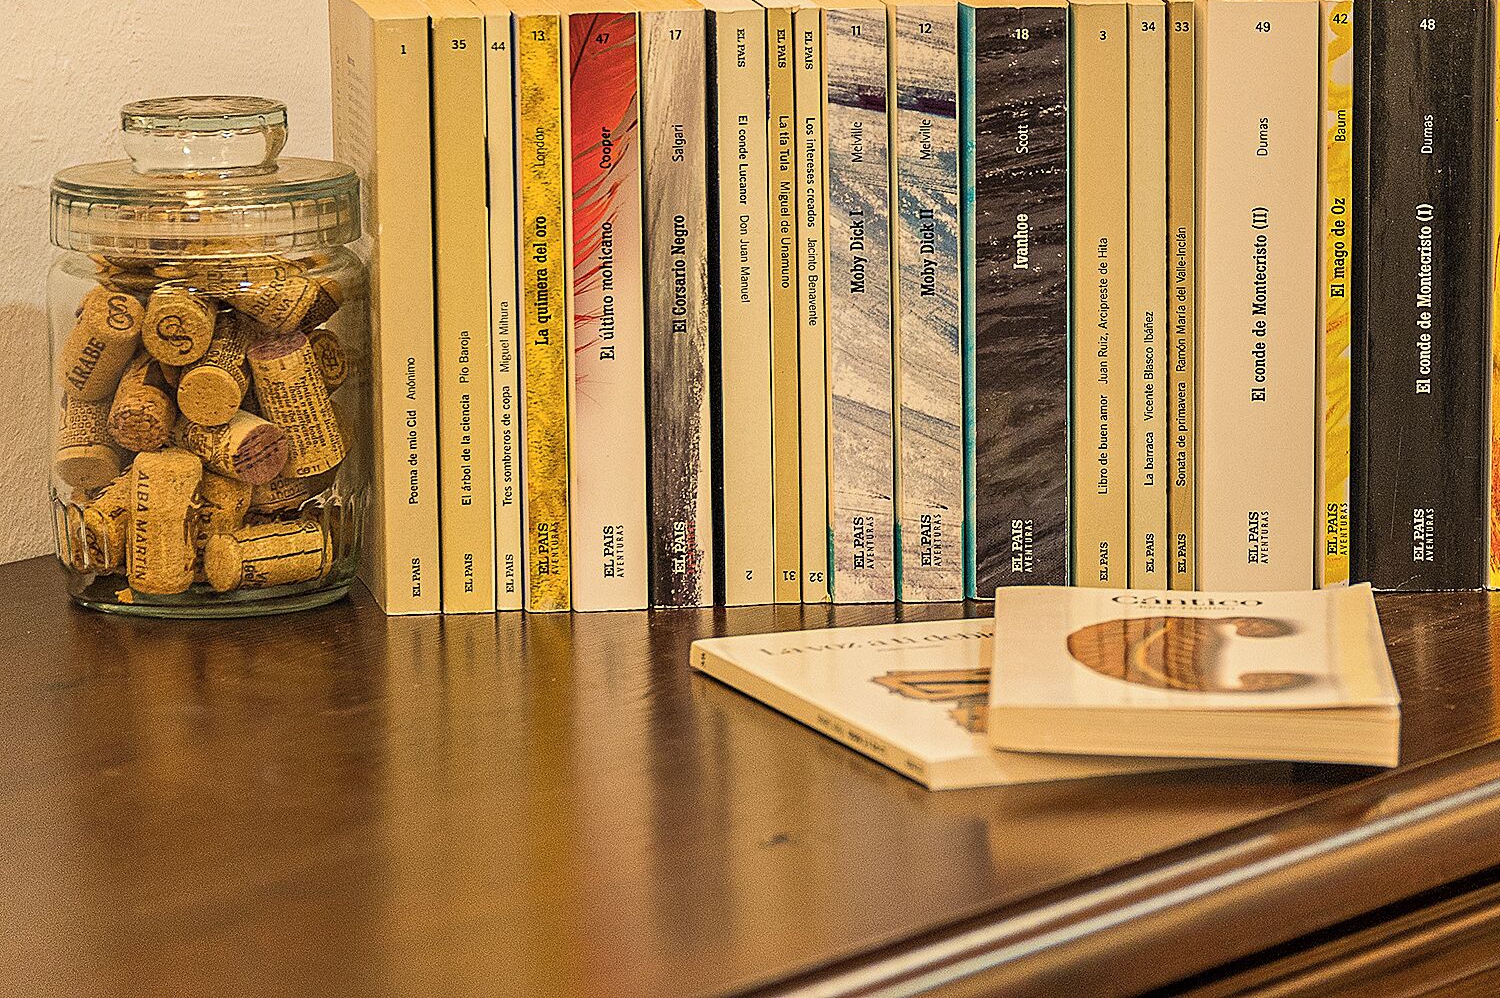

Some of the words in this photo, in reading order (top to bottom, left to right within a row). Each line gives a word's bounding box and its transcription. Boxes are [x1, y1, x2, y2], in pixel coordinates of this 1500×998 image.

[851, 25, 861, 36] 11
[919, 23, 932, 34] 12
[1141, 21, 1156, 32] 34
[1174, 21, 1189, 32] 33
[1255, 21, 1270, 32] 49
[1333, 13, 1348, 24] 42
[1420, 19, 1436, 30] 48
[451, 39, 467, 50] 35
[491, 41, 506, 51] 44
[531, 31, 545, 41] 13
[595, 33, 610, 44] 47
[669, 29, 682, 40] 17
[1015, 28, 1029, 40] 18
[1099, 30, 1107, 41] 3
[400, 44, 407, 55] 1
[739, 114, 748, 125] El
[806, 116, 815, 135] Los
[1335, 108, 1346, 142] Baum
[672, 123, 686, 163] Salgari
[739, 130, 748, 159] conde
[851, 121, 863, 164] Melville
[920, 118, 931, 161] Melville
[1016, 123, 1029, 155] Scott
[1257, 116, 1268, 158] Dumas
[1421, 113, 1433, 155] Dumas
[533, 126, 545, 168] London
[600, 125, 611, 170] Cooper
[807, 140, 816, 184] intereses
[739, 164, 748, 206] Lucanor
[781, 180, 790, 215] Miguel
[807, 189, 816, 229] creados
[1331, 196, 1345, 214] Oz
[920, 208, 936, 219] II
[1252, 205, 1269, 229] (II)
[1416, 202, 1433, 221] (I)
[533, 215, 546, 237] oro
[671, 214, 688, 255] Negro
[740, 214, 749, 234] Don
[781, 221, 790, 232] de
[850, 221, 867, 249] Dick
[1330, 220, 1345, 236] de
[919, 225, 938, 252] Dick
[1013, 211, 1029, 271] Ivanhoe
[1098, 236, 1108, 258] Hita
[533, 243, 547, 262] del
[599, 220, 615, 290] mohicano
[740, 242, 749, 261] Juan
[781, 238, 791, 289] Unamuno
[808, 236, 817, 270] Jacinto
[1176, 226, 1186, 283] Valle-Inclán
[1332, 242, 1348, 278] mago
[849, 258, 867, 295] Moby
[1098, 262, 1107, 274] de
[1252, 235, 1267, 315] Montecristo
[1415, 227, 1431, 307] Montecristo
[671, 260, 689, 315] Corsario
[741, 267, 750, 304] Manuel
[919, 261, 938, 298] Moby
[1331, 284, 1344, 299] El
[533, 268, 549, 323] quimera
[808, 275, 818, 328] Benavente
[1098, 278, 1108, 329] Arcipreste
[1176, 287, 1186, 301] del
[499, 300, 508, 334] Mihura
[599, 296, 614, 340] último
[671, 320, 689, 334] El
[1144, 310, 1153, 342] Ibáñez
[1176, 305, 1186, 334] María
[1252, 321, 1266, 336] de
[1417, 313, 1431, 328] de
[535, 329, 549, 347] La
[1098, 333, 1108, 357] Ruiz,
[500, 340, 510, 374] Miguel
[600, 346, 614, 361] El
[1144, 348, 1153, 379] Blasco
[1176, 339, 1186, 373] Ramón
[1252, 342, 1265, 382] conde
[1416, 334, 1431, 374] conde
[406, 356, 416, 401] Anónimo
[1098, 361, 1108, 385] Juan
[503, 385, 512, 409] copa
[1252, 388, 1265, 403] El
[1416, 380, 1430, 395] El
[460, 393, 470, 431] ciencia
[1144, 385, 1153, 423] Vicente
[1176, 381, 1188, 431] primavera
[407, 409, 416, 426] Cid
[501, 415, 510, 425] de
[407, 431, 417, 449] mio
[461, 436, 470, 444] la
[1098, 424, 1108, 449] buen
[1176, 436, 1188, 447] de
[408, 455, 417, 465] de
[461, 449, 470, 461] de
[502, 431, 511, 481] sombreros
[1098, 453, 1107, 465] de
[1144, 431, 1153, 469] barraca
[461, 466, 471, 491] árbol
[1144, 474, 1153, 487] La
[1176, 452, 1188, 488] Sonata
[409, 470, 418, 506] Poema
[1098, 469, 1107, 496] Libro
[462, 496, 471, 507] El
[503, 488, 512, 507] Tres
[1249, 510, 1259, 542] PAIS
[1261, 510, 1269, 565] AVENTURAS
[604, 524, 614, 556] PAIS
[1248, 543, 1258, 564] EL
[604, 558, 614, 579] EL
[746, 570, 753, 580] 2
[782, 570, 796, 580] 31
[808, 571, 824, 582] 32
